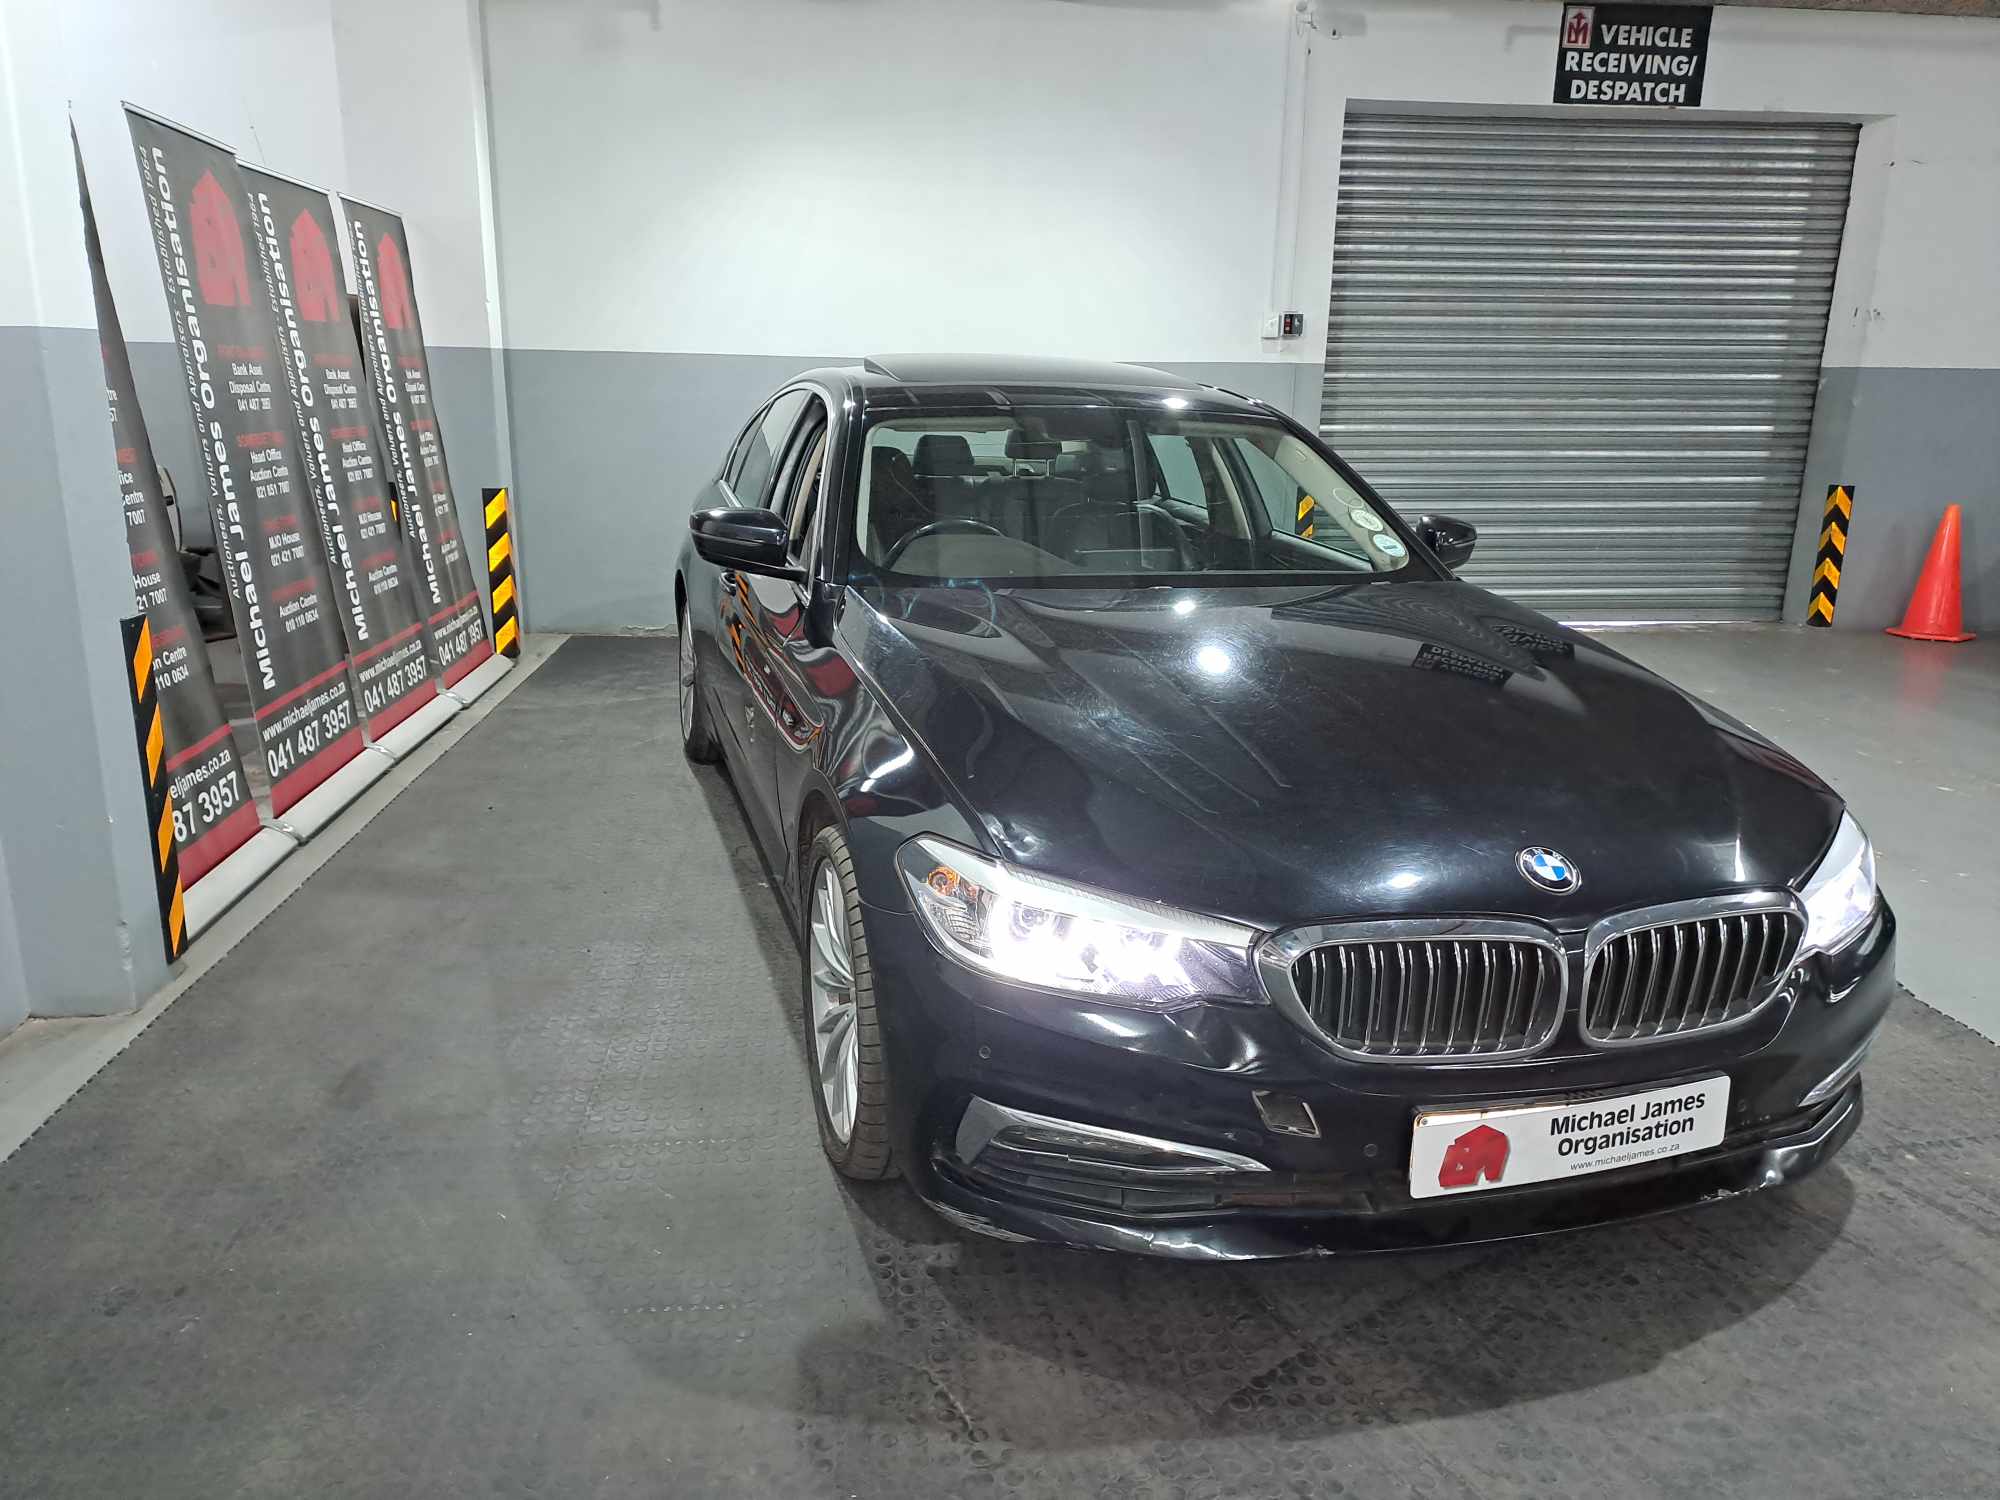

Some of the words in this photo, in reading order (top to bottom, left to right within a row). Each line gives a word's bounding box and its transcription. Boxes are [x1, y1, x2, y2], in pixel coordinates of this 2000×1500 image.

[1564, 51, 1698, 76] RECEIVING/
[1601, 24, 1693, 48] VEHICLE
[1569, 79, 1686, 103] DESPATCH
[152, 147, 215, 409] Organisation
[258, 192, 313, 407] Organisation
[354, 221, 397, 403] Organisation
[175, 310, 198, 398] Appraisers
[192, 400, 205, 433] and
[293, 400, 305, 427] and
[202, 439, 218, 496] Valuers
[210, 421, 244, 540] James
[302, 431, 317, 479] Valuers
[309, 417, 340, 516] James
[393, 412, 418, 496] James
[133, 571, 161, 590] House
[332, 525, 369, 640] Michael
[411, 504, 441, 604] Michael
[149, 587, 168, 607] 7007
[235, 551, 276, 690] Michael
[438, 642, 454, 666] 041
[454, 631, 468, 657] 487
[467, 618, 483, 648] 3957
[262, 680, 346, 742] www.michaeljames.co.za
[363, 684, 384, 713] 041
[386, 668, 406, 699] 487
[404, 654, 428, 690] 3957
[267, 740, 295, 778] 041
[297, 722, 321, 757] 487
[323, 699, 352, 740] 3957
[198, 770, 241, 824] 3957
[1550, 1102, 1635, 1136] Michael
[1640, 1092, 1705, 1122] James
[1558, 1114, 1695, 1156] Organisation
[1570, 1143, 1680, 1171] www.michaeljames.co.za
